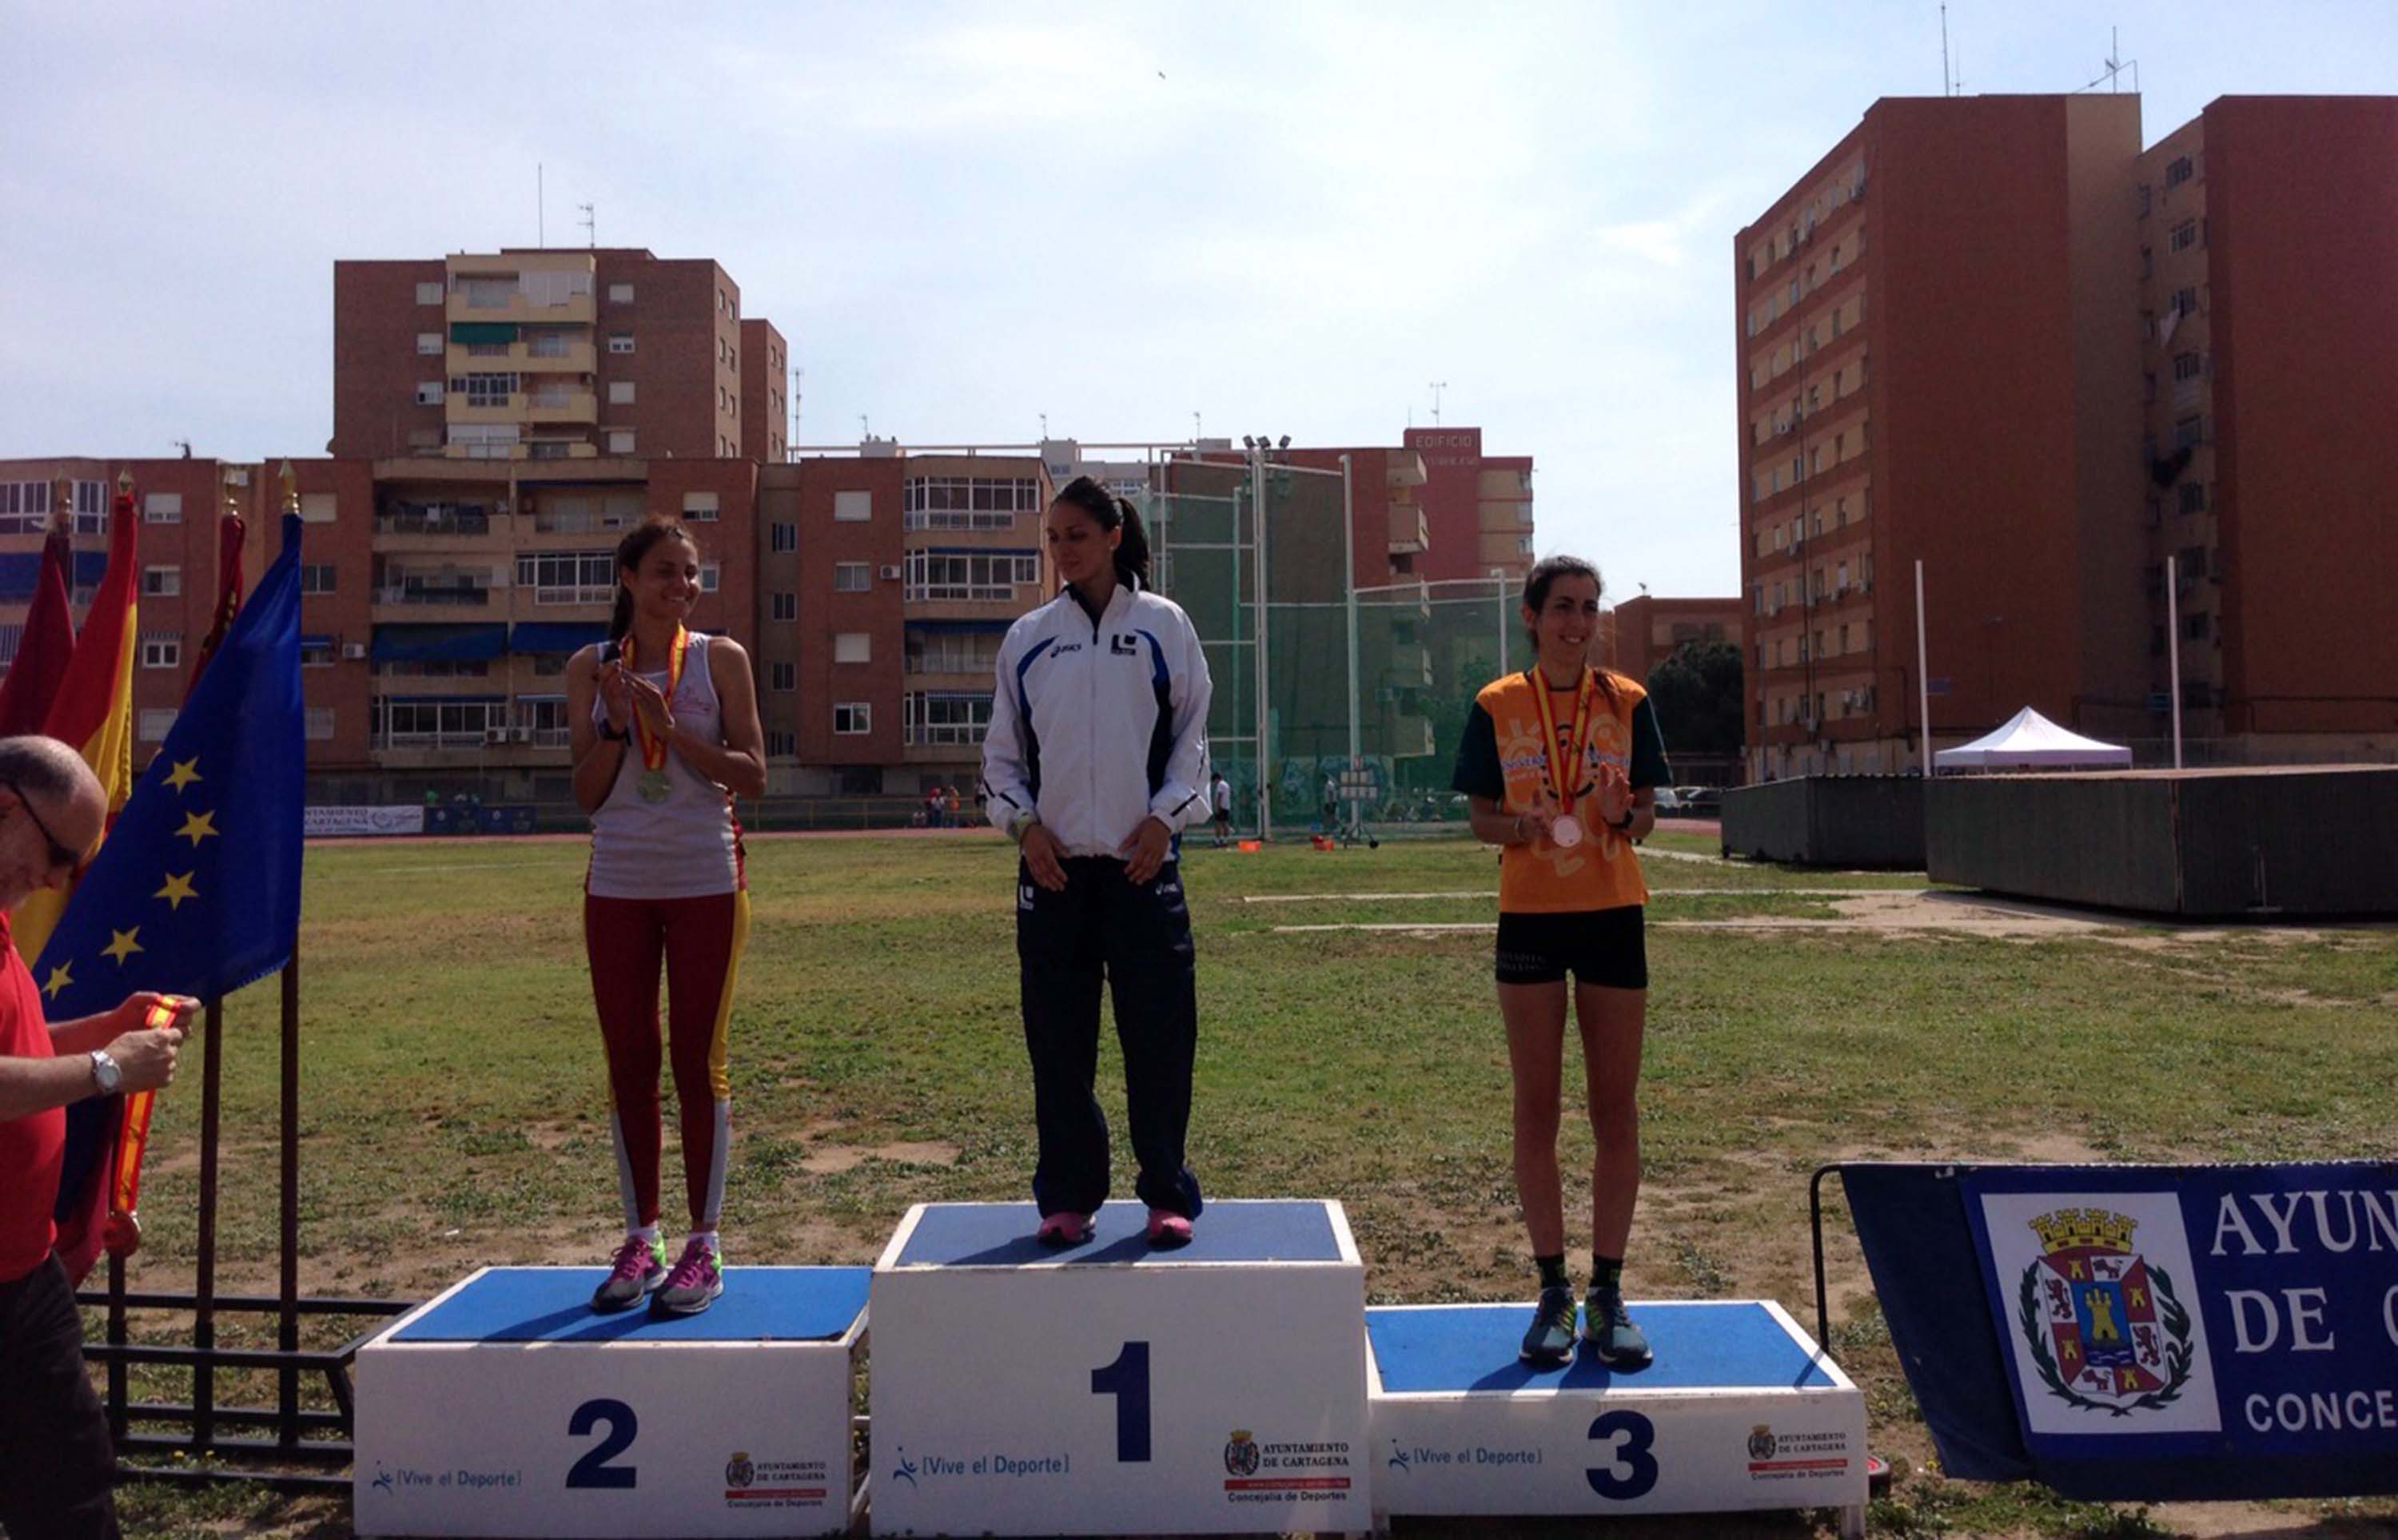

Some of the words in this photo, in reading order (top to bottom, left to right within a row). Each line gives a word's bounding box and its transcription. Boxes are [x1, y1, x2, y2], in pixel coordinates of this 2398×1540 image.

[1416, 436, 1472, 448] EDIFICIO
[2210, 1190, 2398, 1255] AYUN
[2224, 1287, 2334, 1352] DE
[1092, 1342, 1151, 1462] 1
[2245, 1391, 2398, 1431] CONCE
[565, 1399, 637, 1489] 2
[1263, 1443, 1349, 1454] AYUNTAMIENTO
[1263, 1457, 1277, 1467] DE
[1283, 1455, 1349, 1467] CARTAGENA
[1458, 1447, 1470, 1462] el
[1586, 1410, 1658, 1499] 3
[972, 1455, 986, 1474] el
[440, 1471, 452, 1484] el
[1285, 1491, 1297, 1502] de
[1301, 1490, 1347, 1502] Deportes
